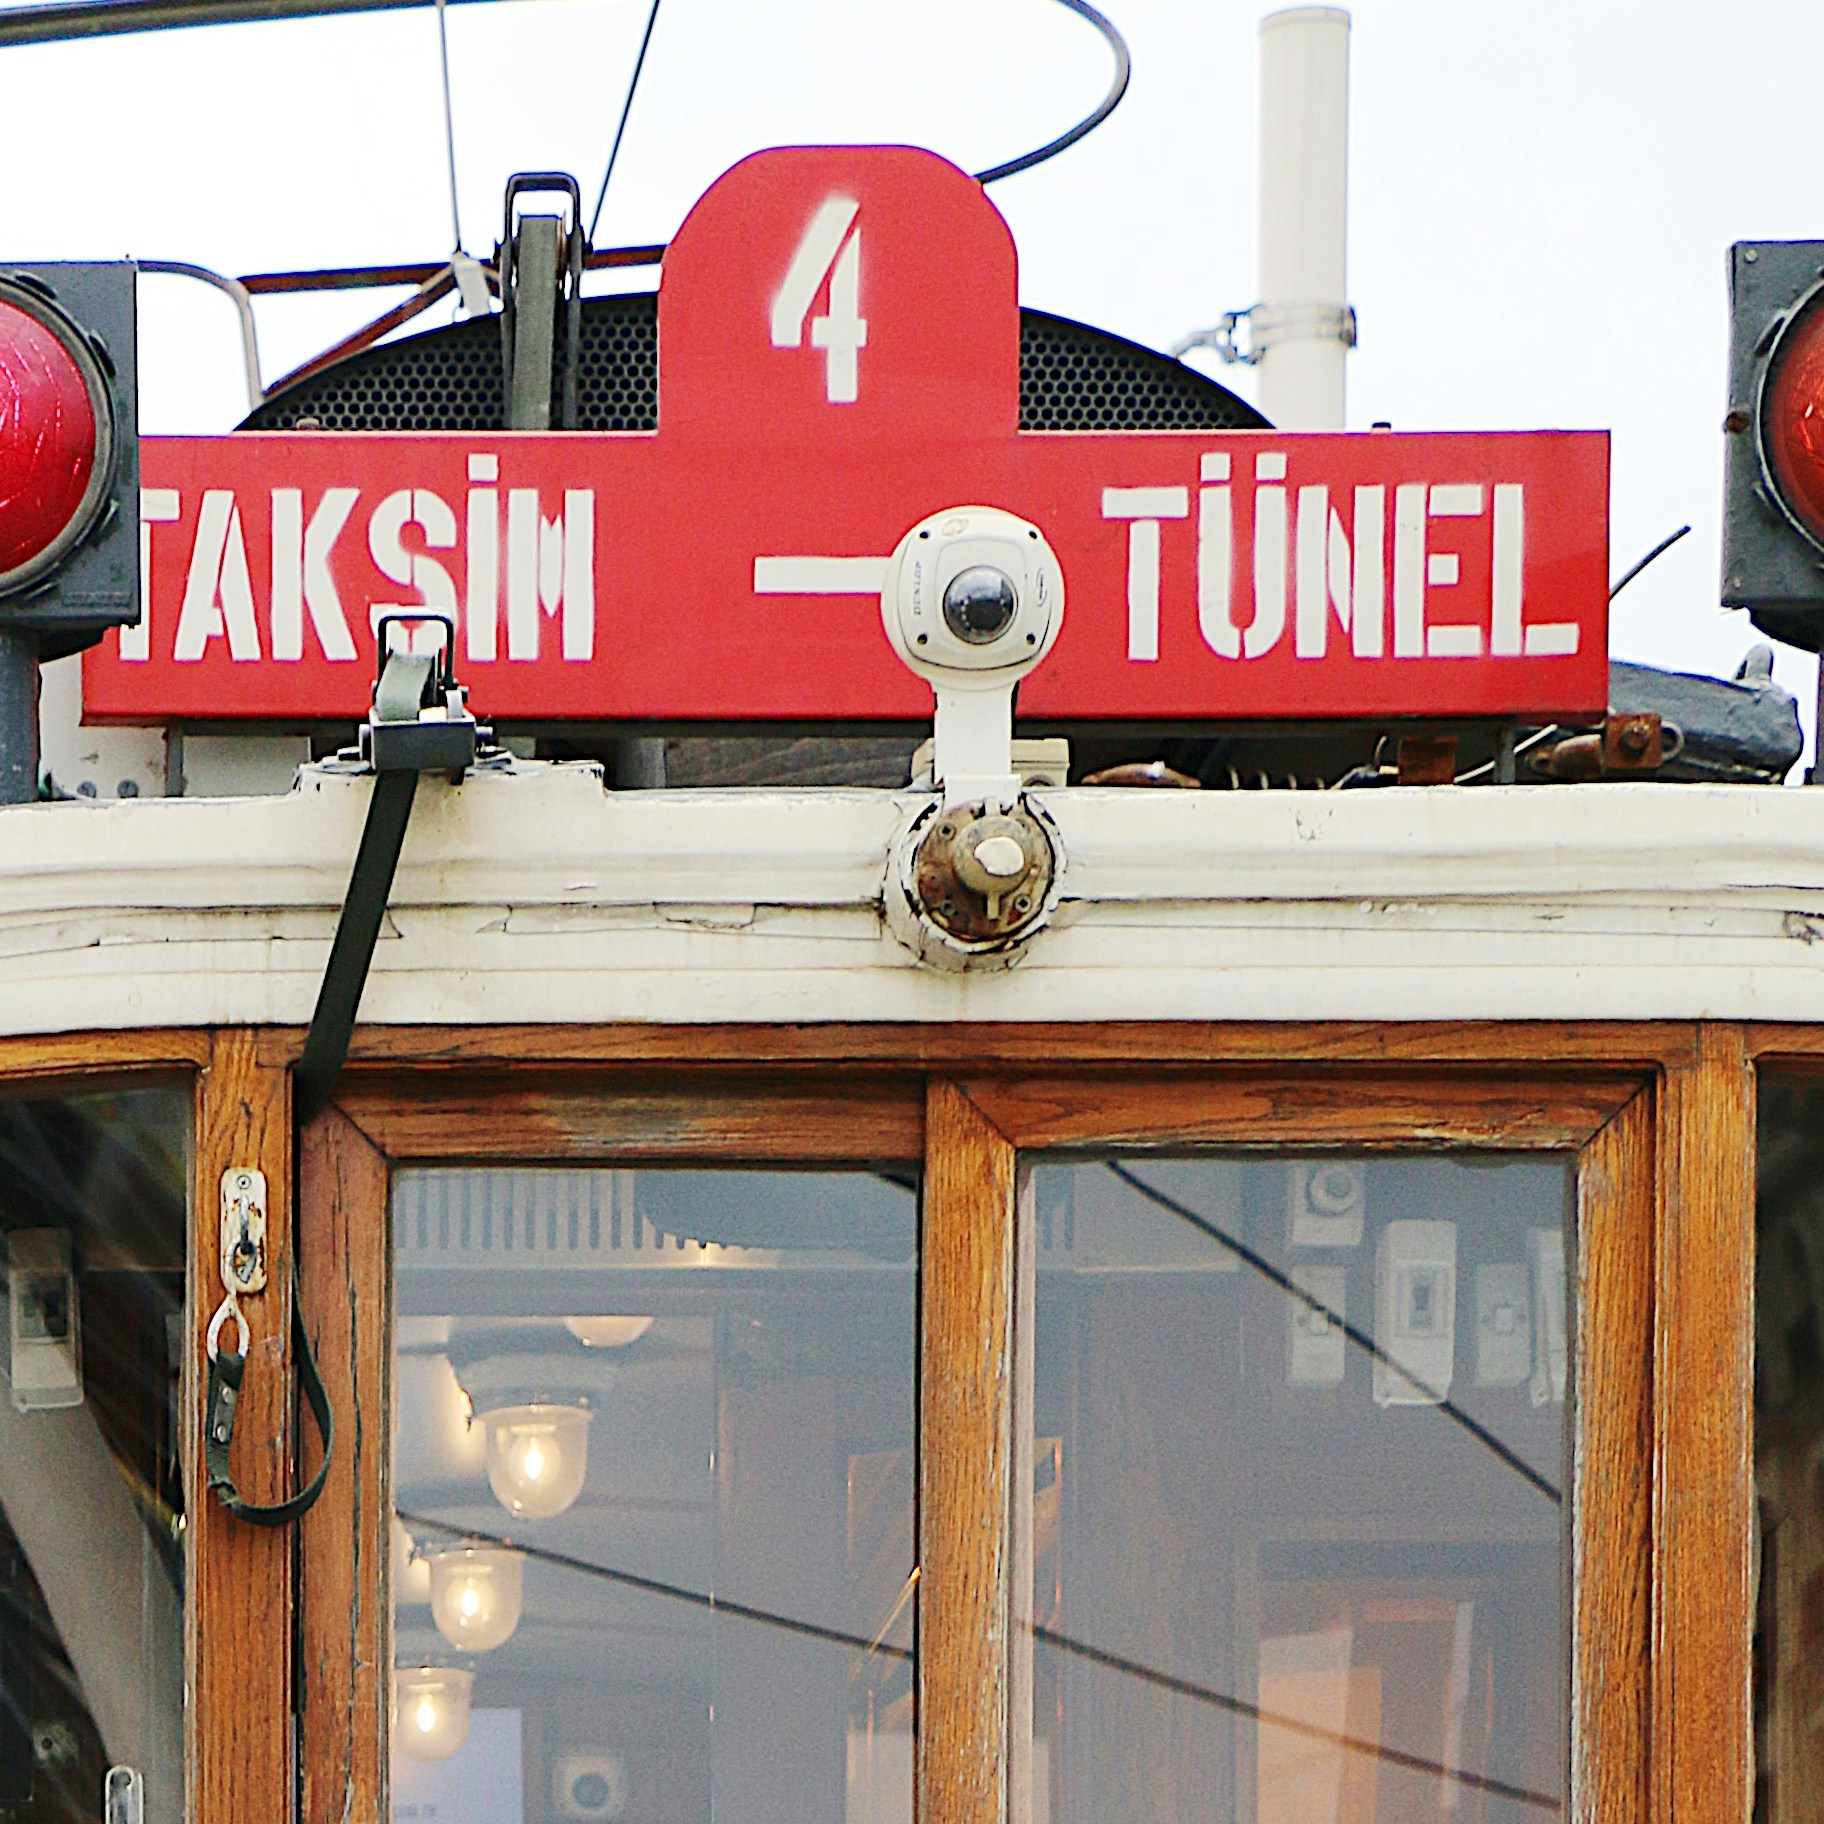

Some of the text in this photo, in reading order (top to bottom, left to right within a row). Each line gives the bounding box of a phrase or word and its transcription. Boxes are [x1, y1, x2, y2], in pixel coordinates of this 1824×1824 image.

[770, 196, 867, 402] 4
[118, 452, 1580, 662] TAKSİM TÜNEL
